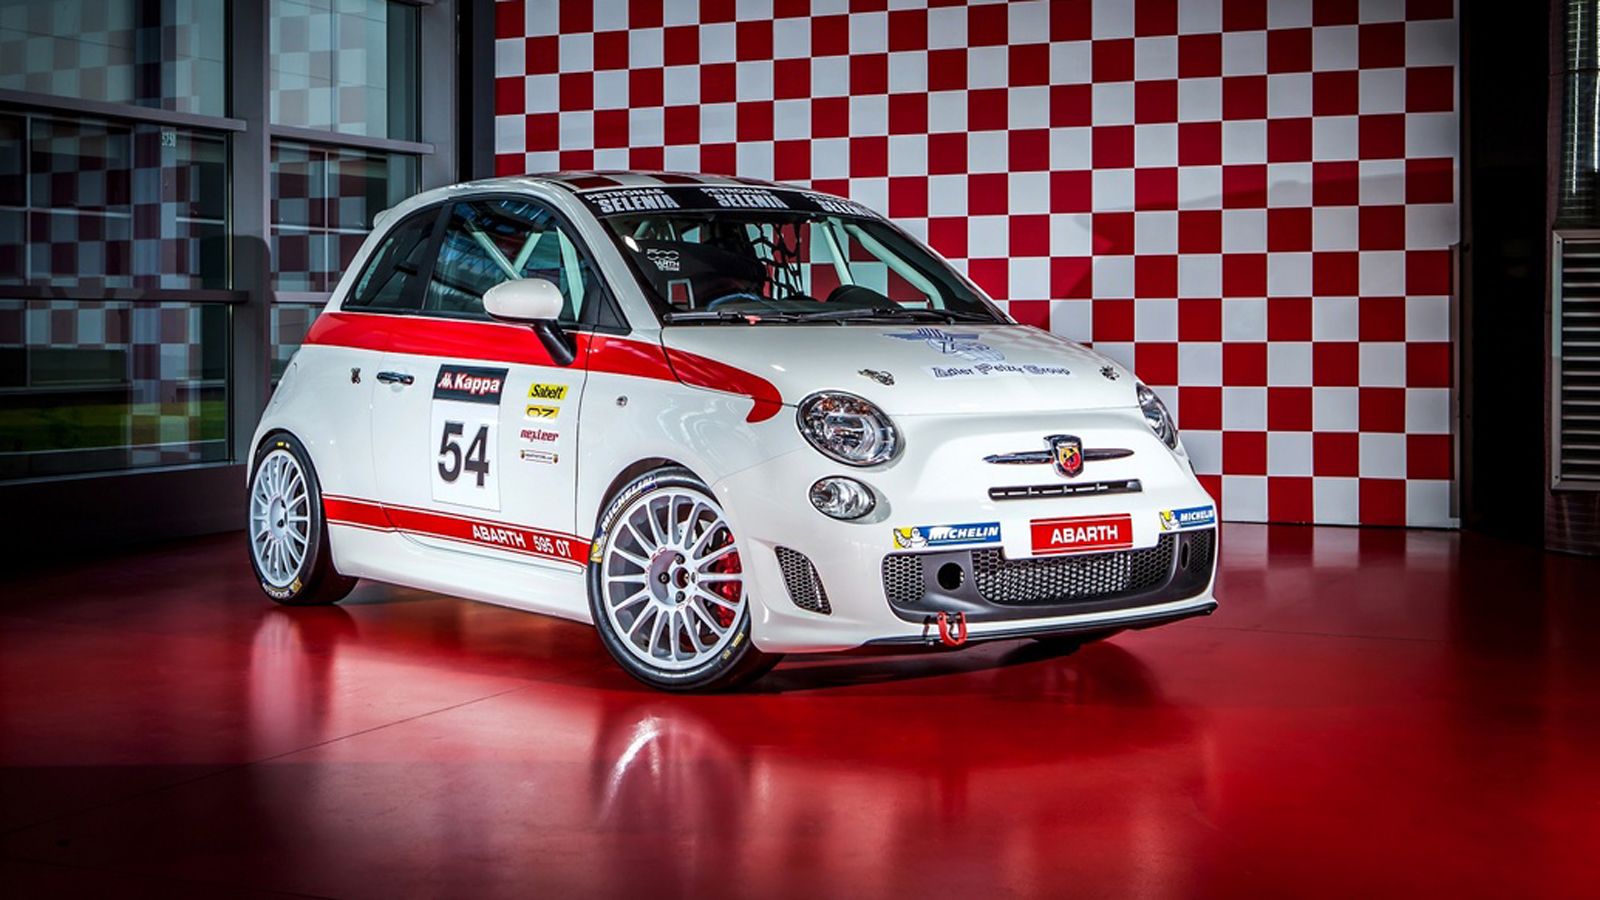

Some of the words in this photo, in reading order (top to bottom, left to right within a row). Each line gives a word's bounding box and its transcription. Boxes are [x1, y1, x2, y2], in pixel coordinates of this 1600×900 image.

[598, 194, 681, 214] SELENIA
[713, 194, 790, 209] SELENIA
[454, 372, 501, 395] Kappa
[531, 384, 564, 399] Sabelt
[438, 420, 489, 487] 54
[472, 524, 527, 548] ABARTH
[532, 535, 554, 554] 595
[556, 540, 573, 558] OT
[928, 526, 999, 541] MICHELIN
[1050, 524, 1119, 545] ABARTH
